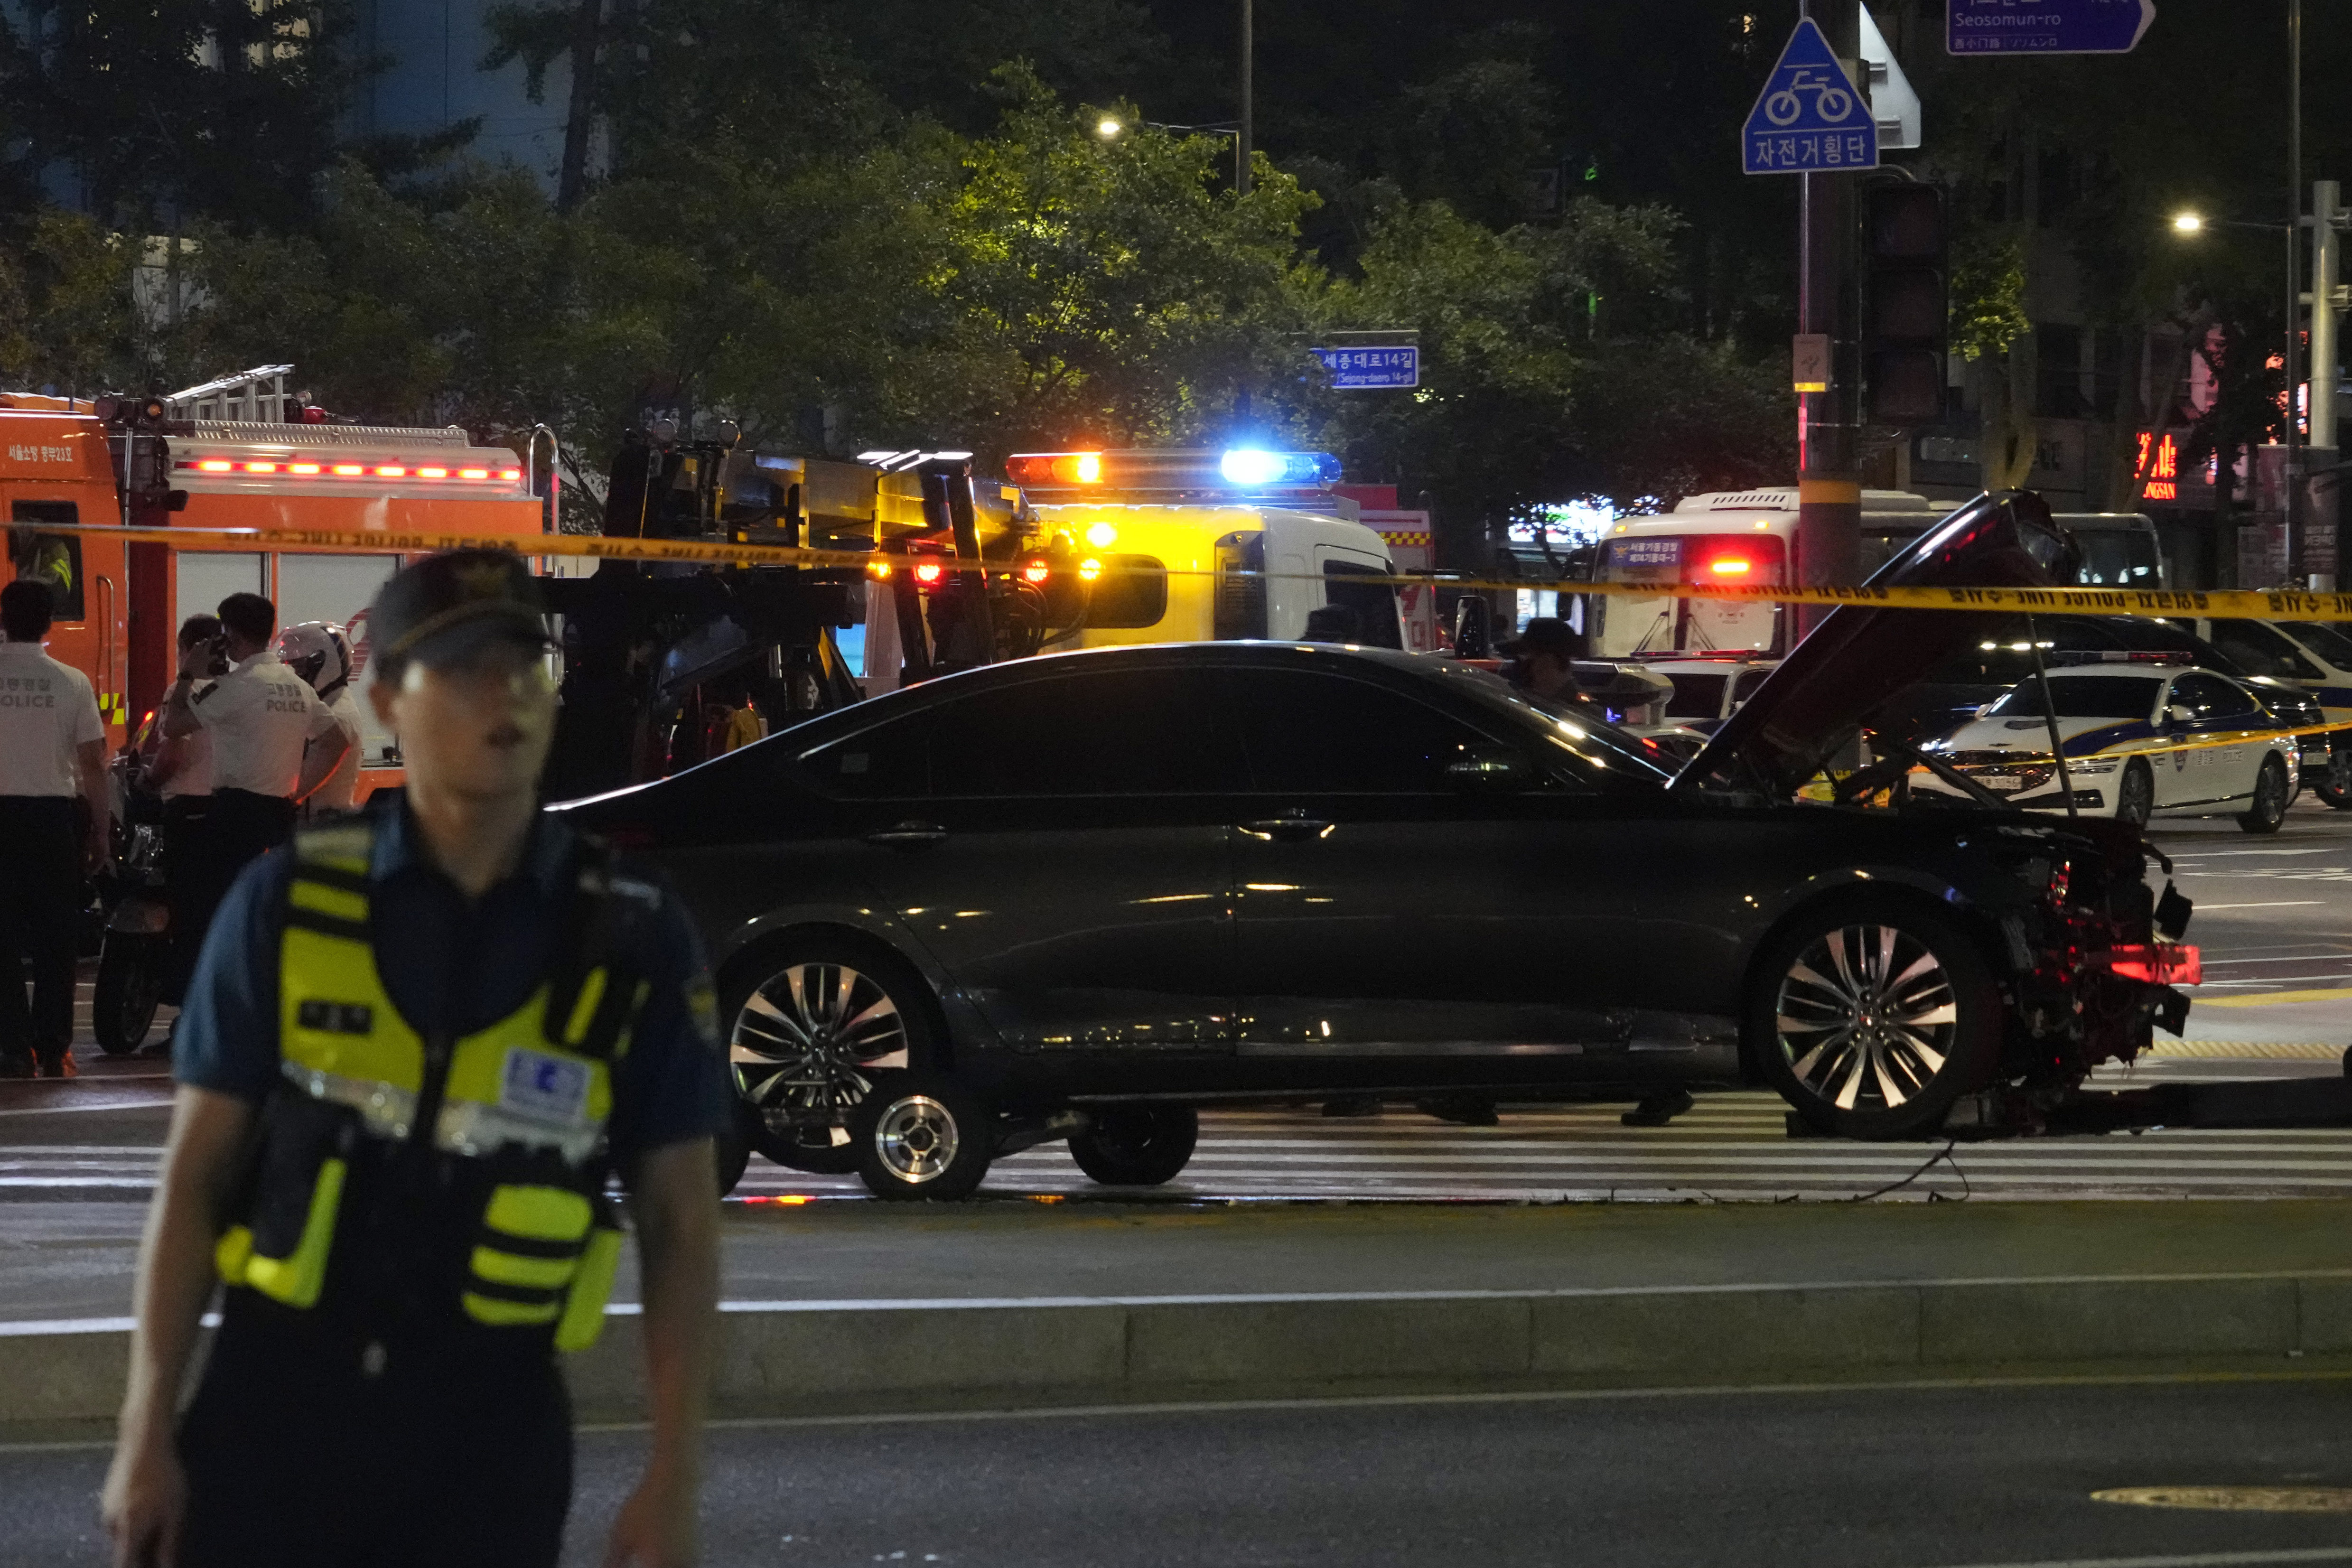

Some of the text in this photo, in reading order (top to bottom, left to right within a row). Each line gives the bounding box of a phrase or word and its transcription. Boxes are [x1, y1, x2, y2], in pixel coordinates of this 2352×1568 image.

[1955, 12, 2062, 27] Seosomun-ro
[1756, 135, 1866, 167] 자전거횡단
[1323, 352, 1413, 369] 세종대로14길
[9, 444, 38, 462] 서울소방
[0, 694, 55, 708] OLICE
[266, 699, 306, 713] POLICE
